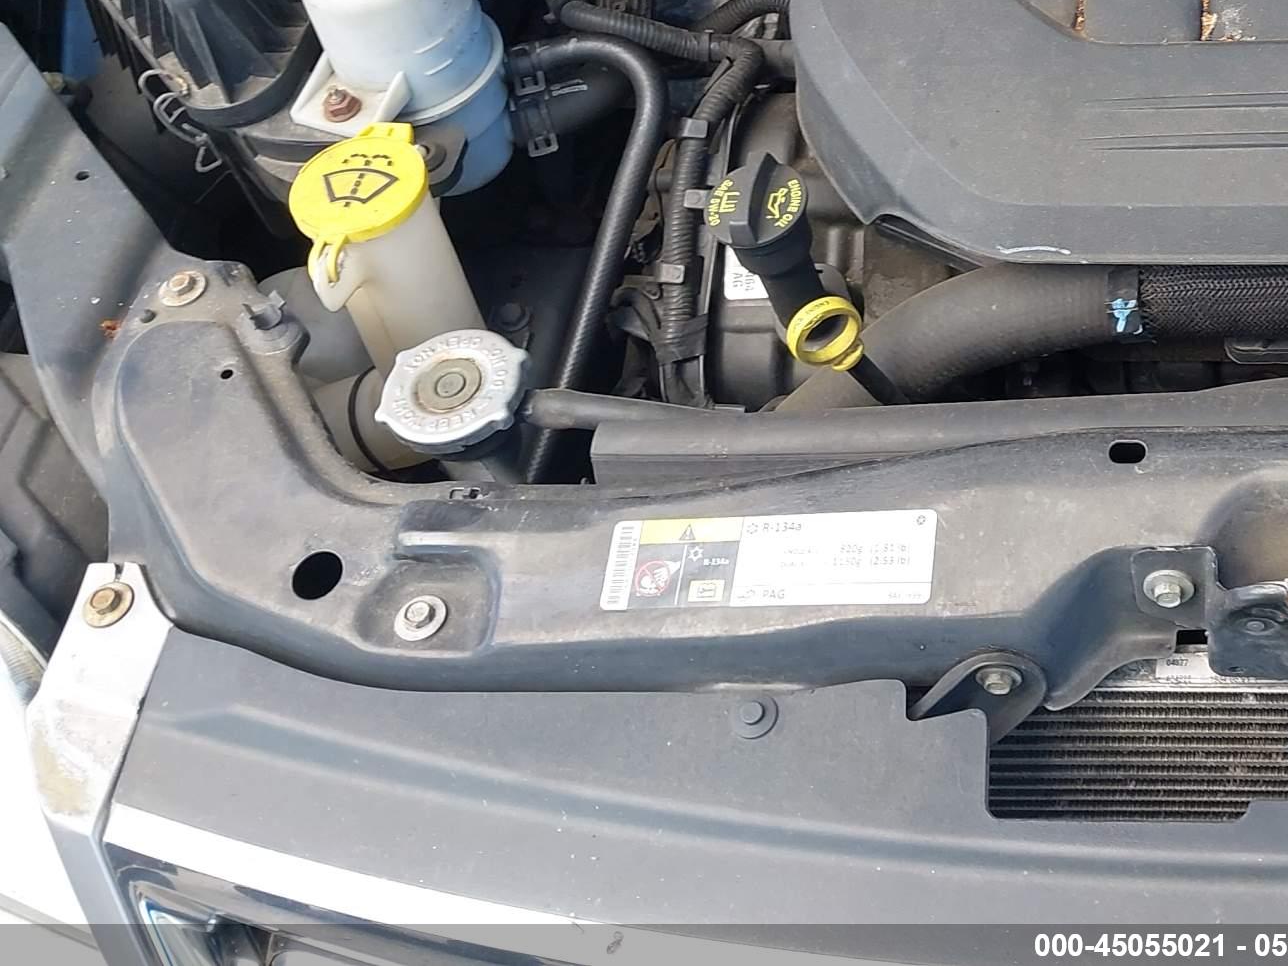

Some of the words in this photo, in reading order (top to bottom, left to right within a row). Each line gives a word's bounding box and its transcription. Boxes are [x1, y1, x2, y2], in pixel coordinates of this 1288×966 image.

[713, 179, 734, 197] SAE
[786, 178, 802, 212] ENGINE
[774, 213, 793, 229] OIL
[762, 521, 803, 533] R-134a
[761, 589, 785, 600] PAG
